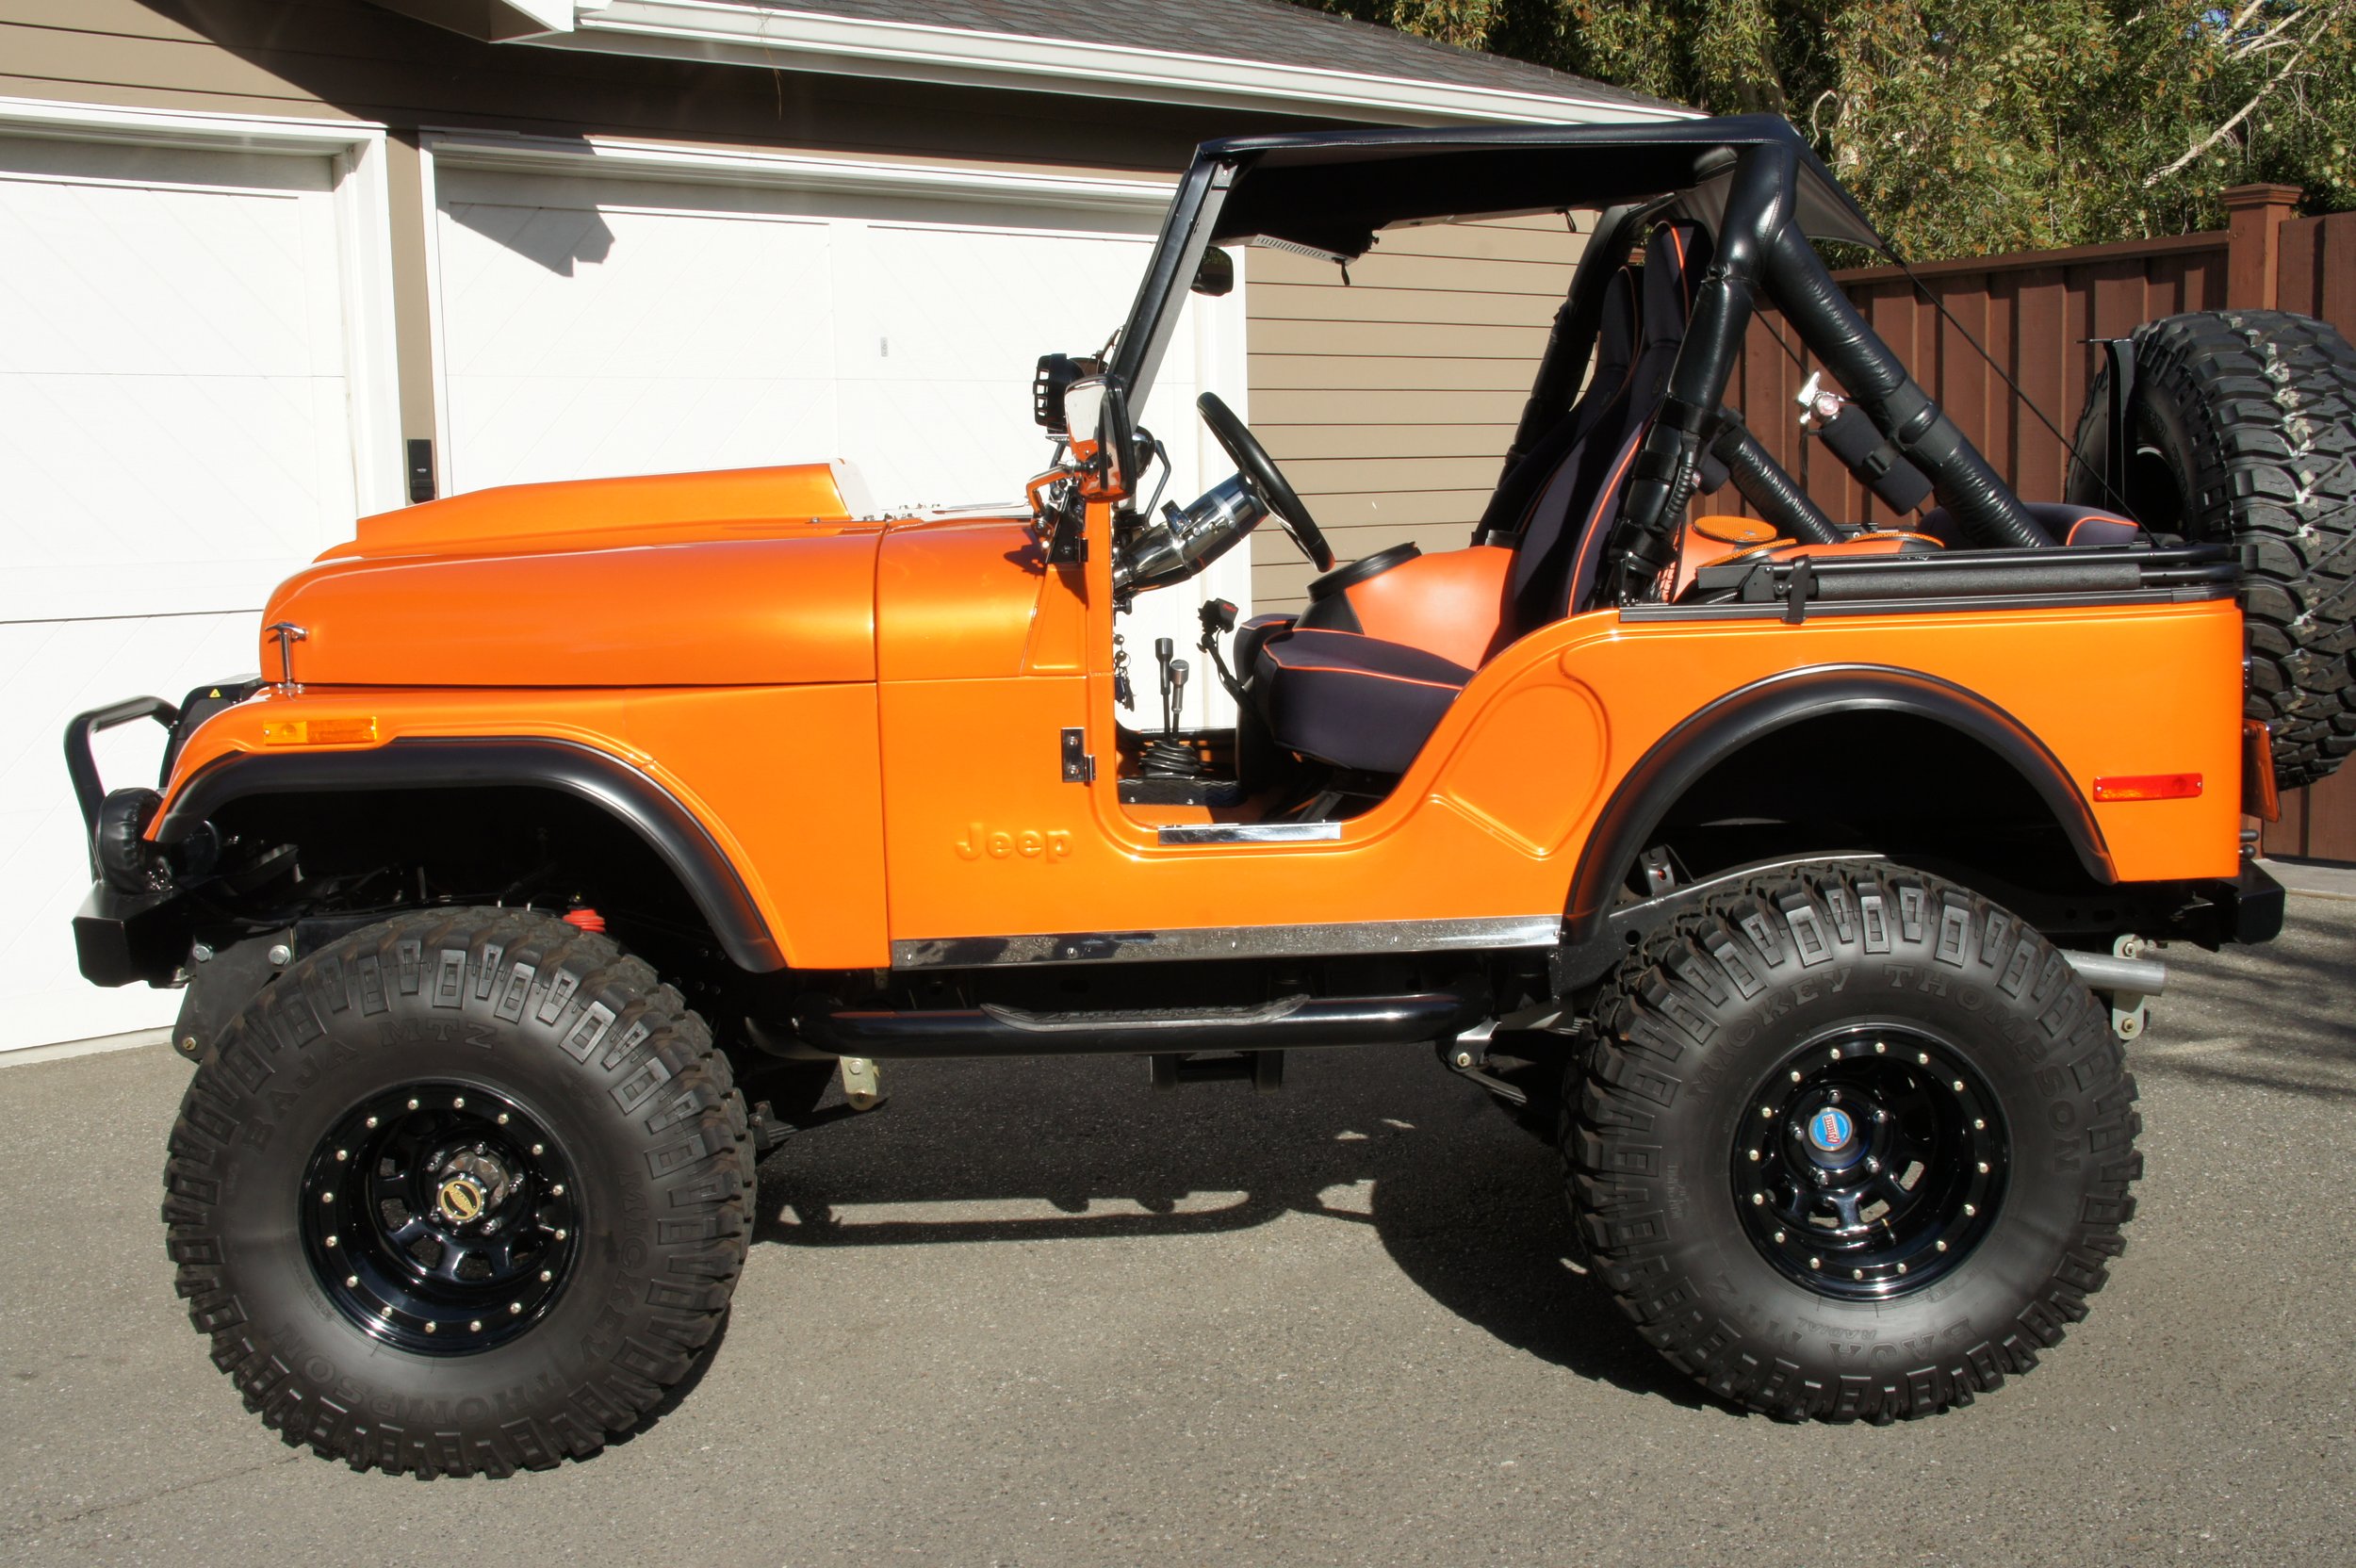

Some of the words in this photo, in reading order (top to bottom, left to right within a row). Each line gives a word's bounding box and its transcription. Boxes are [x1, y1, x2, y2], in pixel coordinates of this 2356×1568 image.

[954, 822, 1072, 864] Jeep
[239, 1038, 360, 1155] BAJA
[377, 1017, 499, 1050] MTZ
[1683, 965, 1853, 1104] MICKEY
[1884, 963, 2082, 1173] THOMPSON
[579, 1170, 650, 1365] MICKEY
[270, 1326, 564, 1427] THOMPSON
[1825, 1316, 1977, 1364] BAJA
